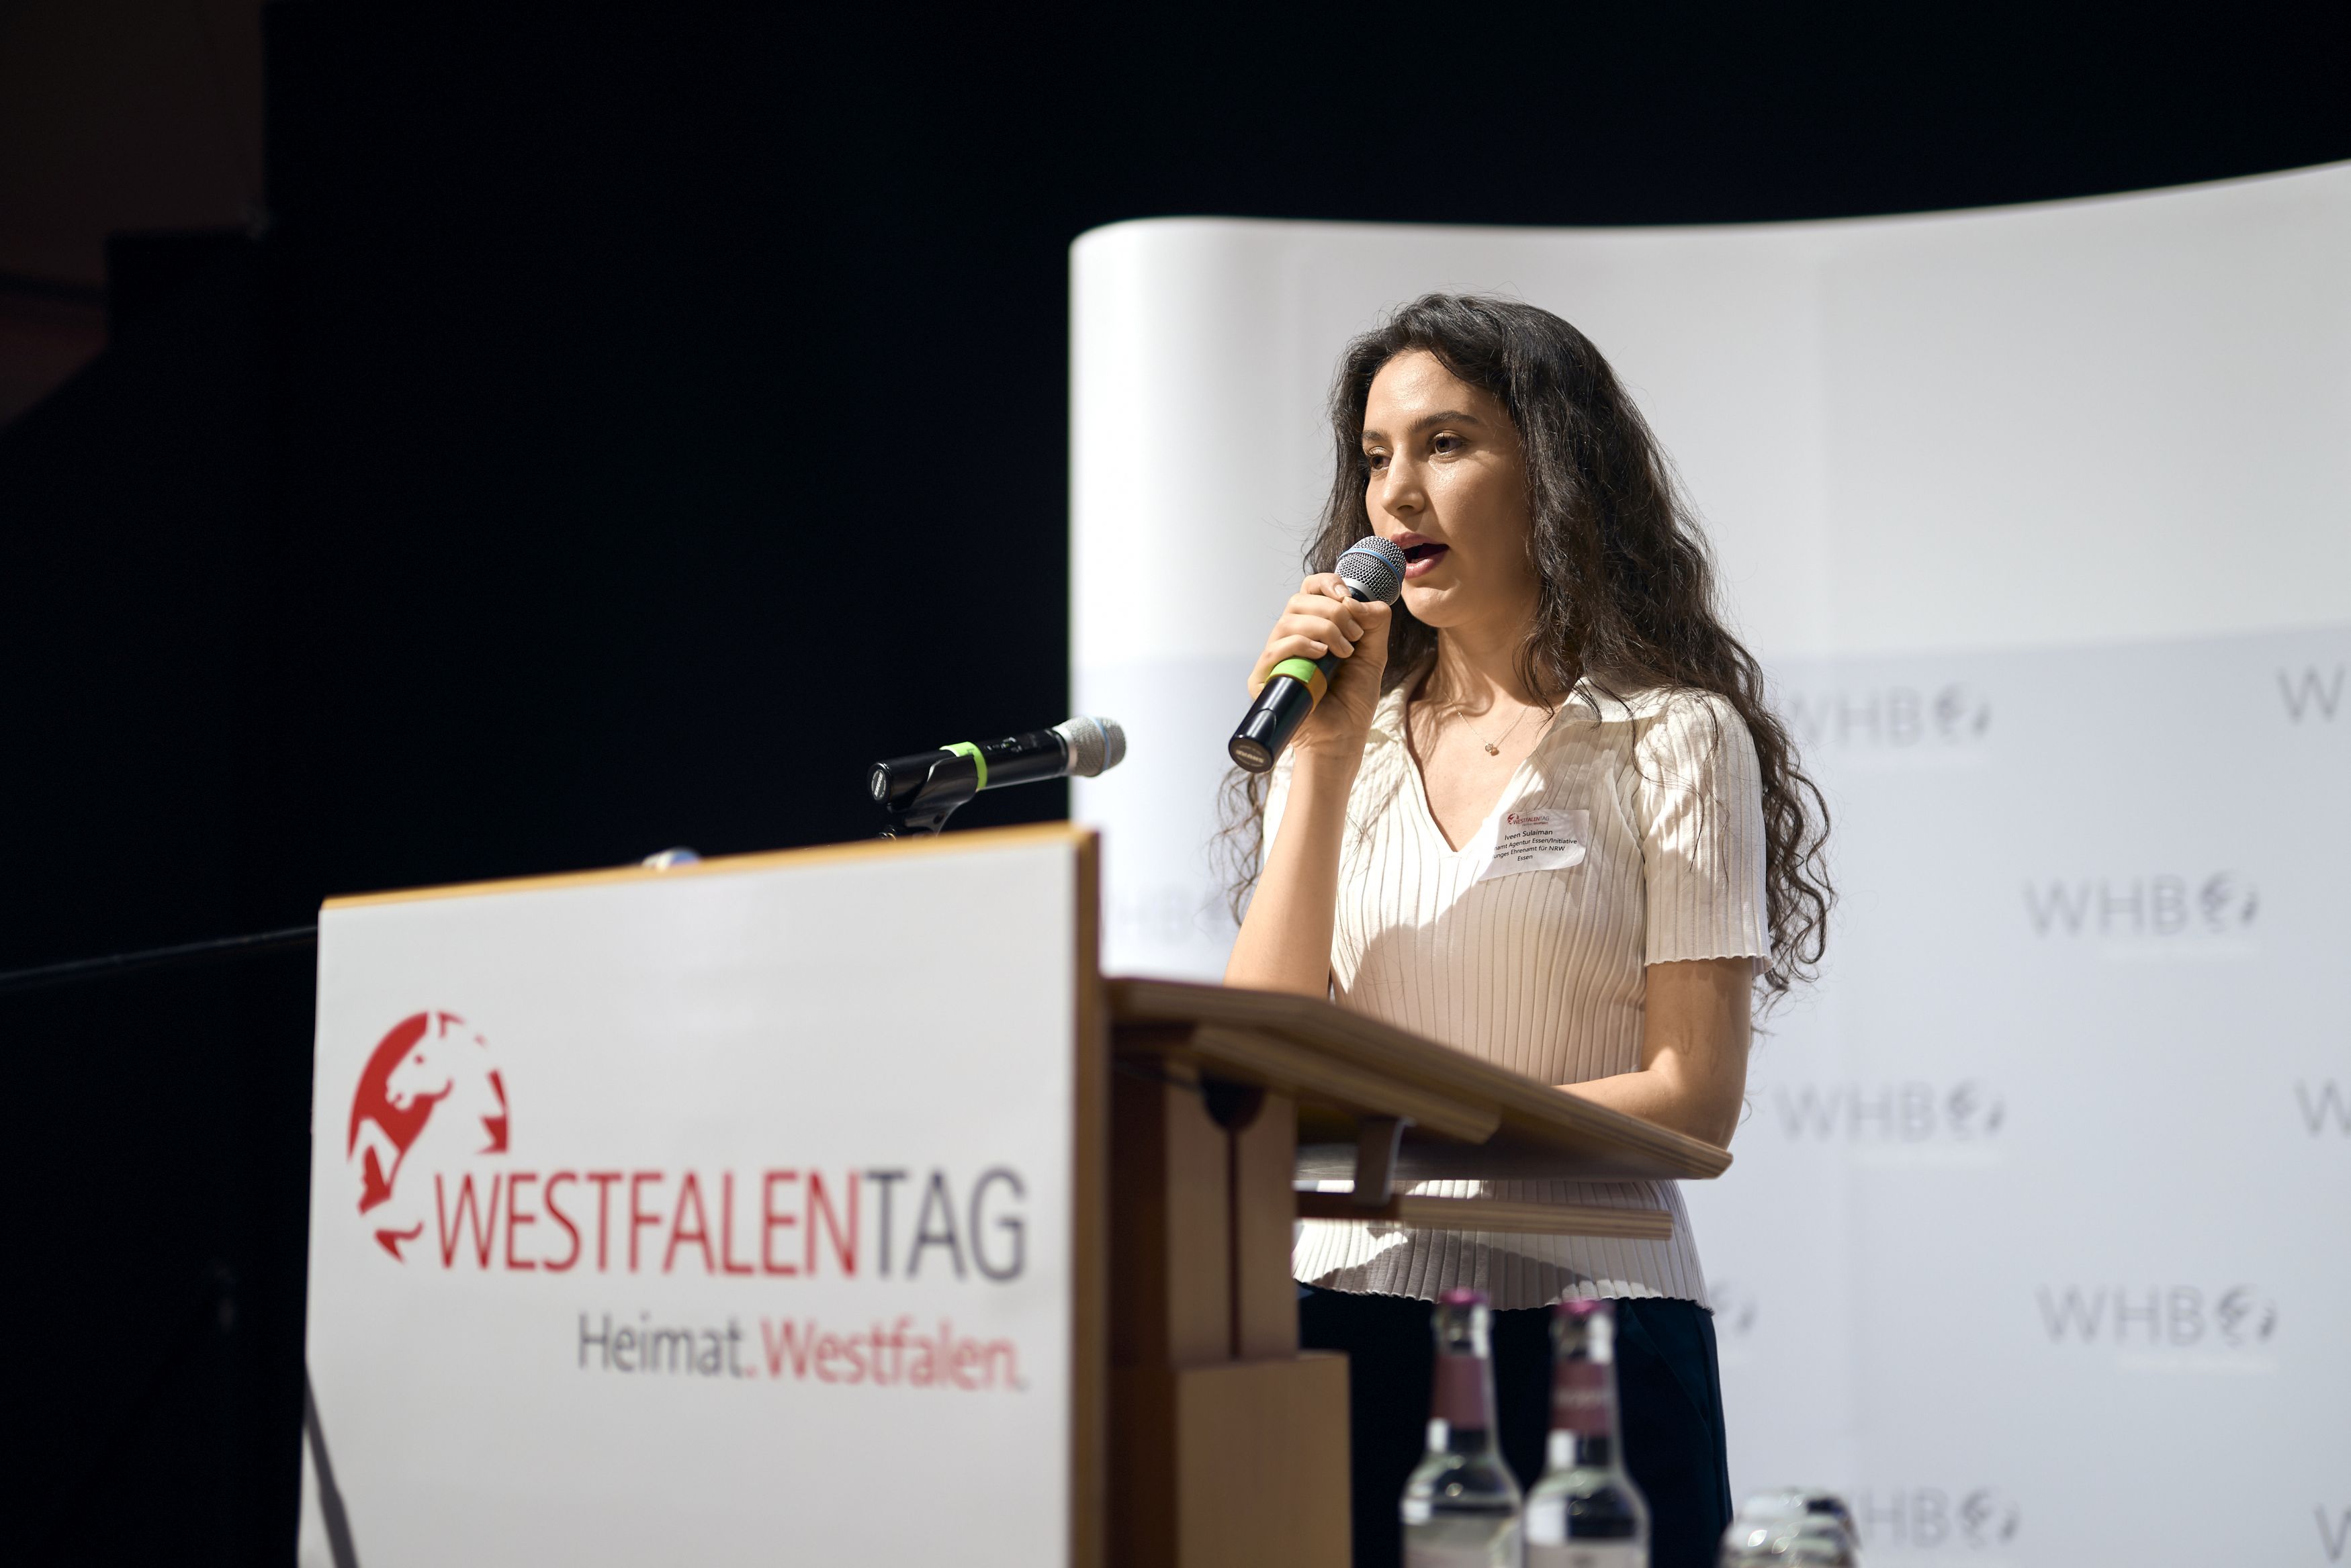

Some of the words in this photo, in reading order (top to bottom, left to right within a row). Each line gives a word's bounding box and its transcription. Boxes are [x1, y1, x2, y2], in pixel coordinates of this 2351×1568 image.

[1508, 839, 1531, 847] Agentur
[1510, 846, 1538, 855] Ehrenamt
[1522, 829, 1553, 837] Sulaiman
[2021, 873, 2188, 938] WHB
[1771, 1080, 1937, 1144] WHB
[433, 1167, 1028, 1283] WESTFALENTAG
[2033, 1281, 2207, 1347] WHB
[1860, 1488, 1951, 1550] HB
